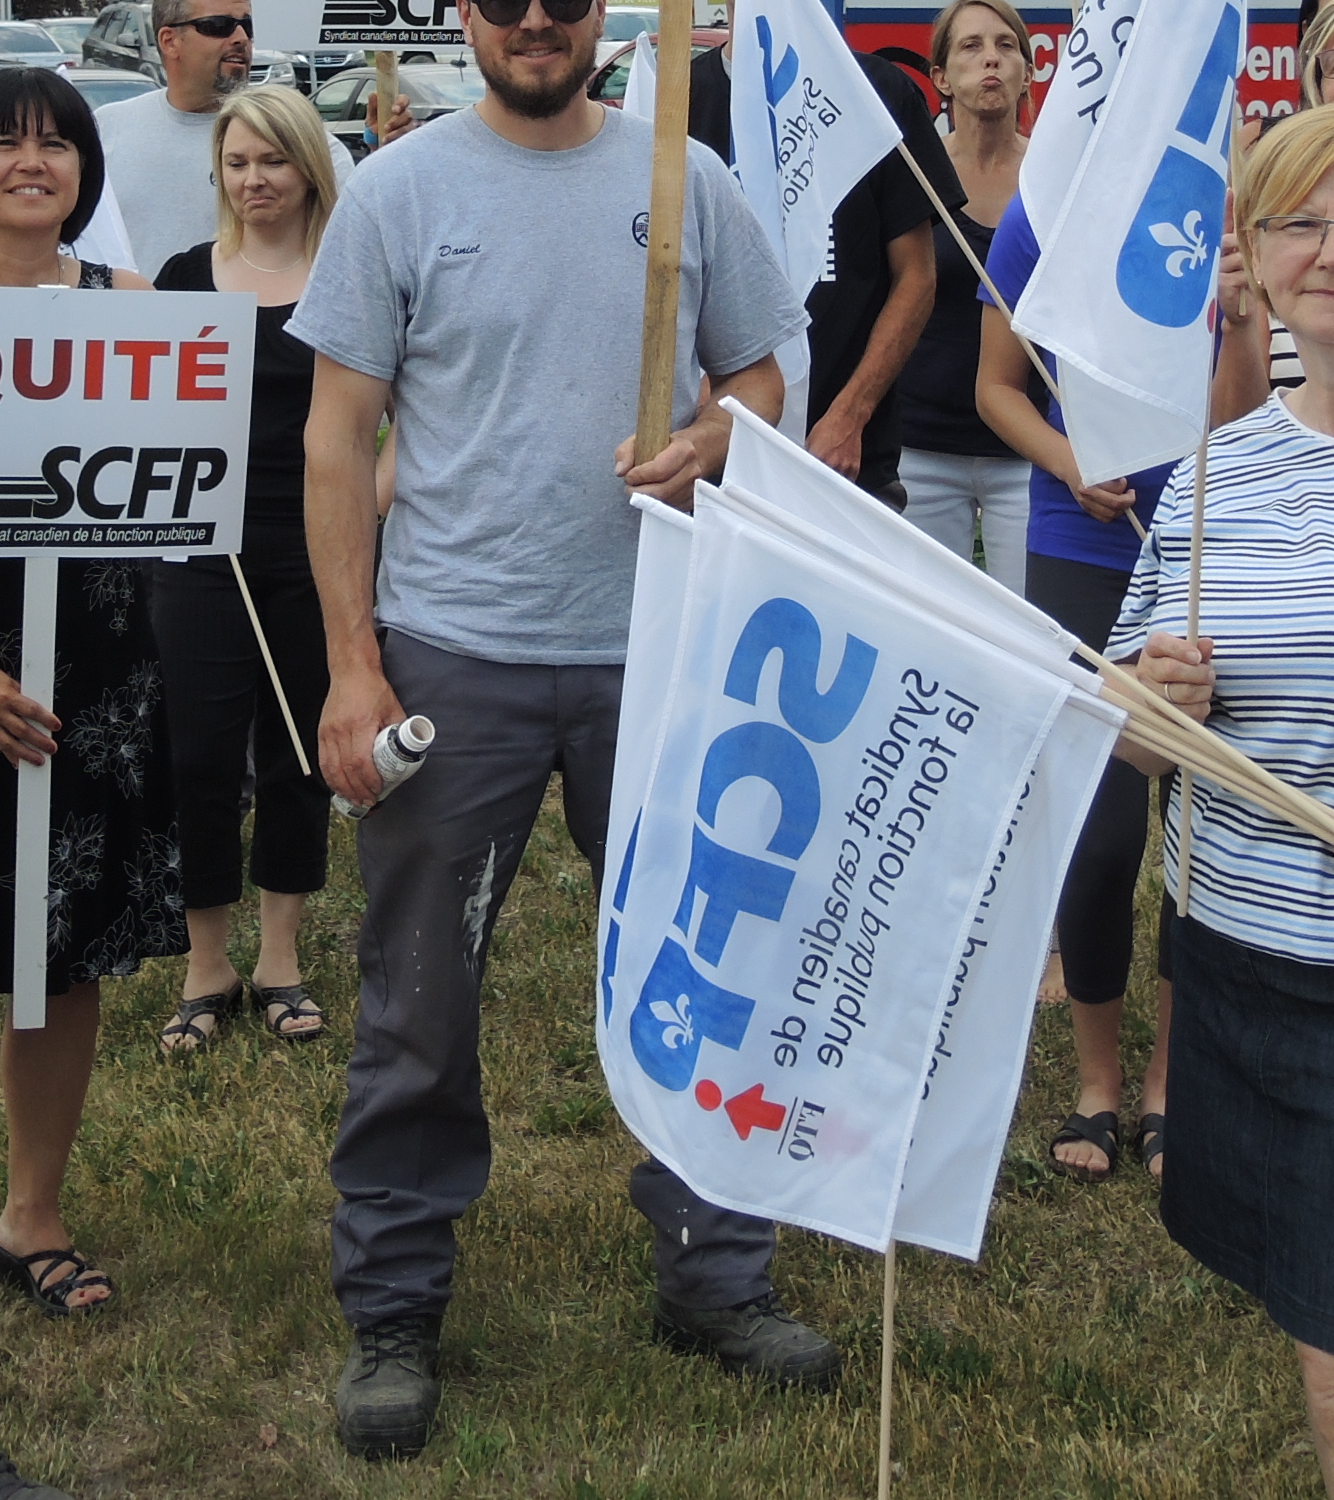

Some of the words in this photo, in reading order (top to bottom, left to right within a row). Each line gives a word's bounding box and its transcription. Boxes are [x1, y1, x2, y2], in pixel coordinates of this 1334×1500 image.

[399, 31, 409, 41] de
[439, 244, 481, 257] Daniel
[32, 446, 229, 520] SCFP
[13, 527, 69, 542] canadien
[72, 527, 89, 542] de
[92, 527, 103, 542] la
[105, 526, 153, 542] fonction
[155, 526, 206, 545] publique
